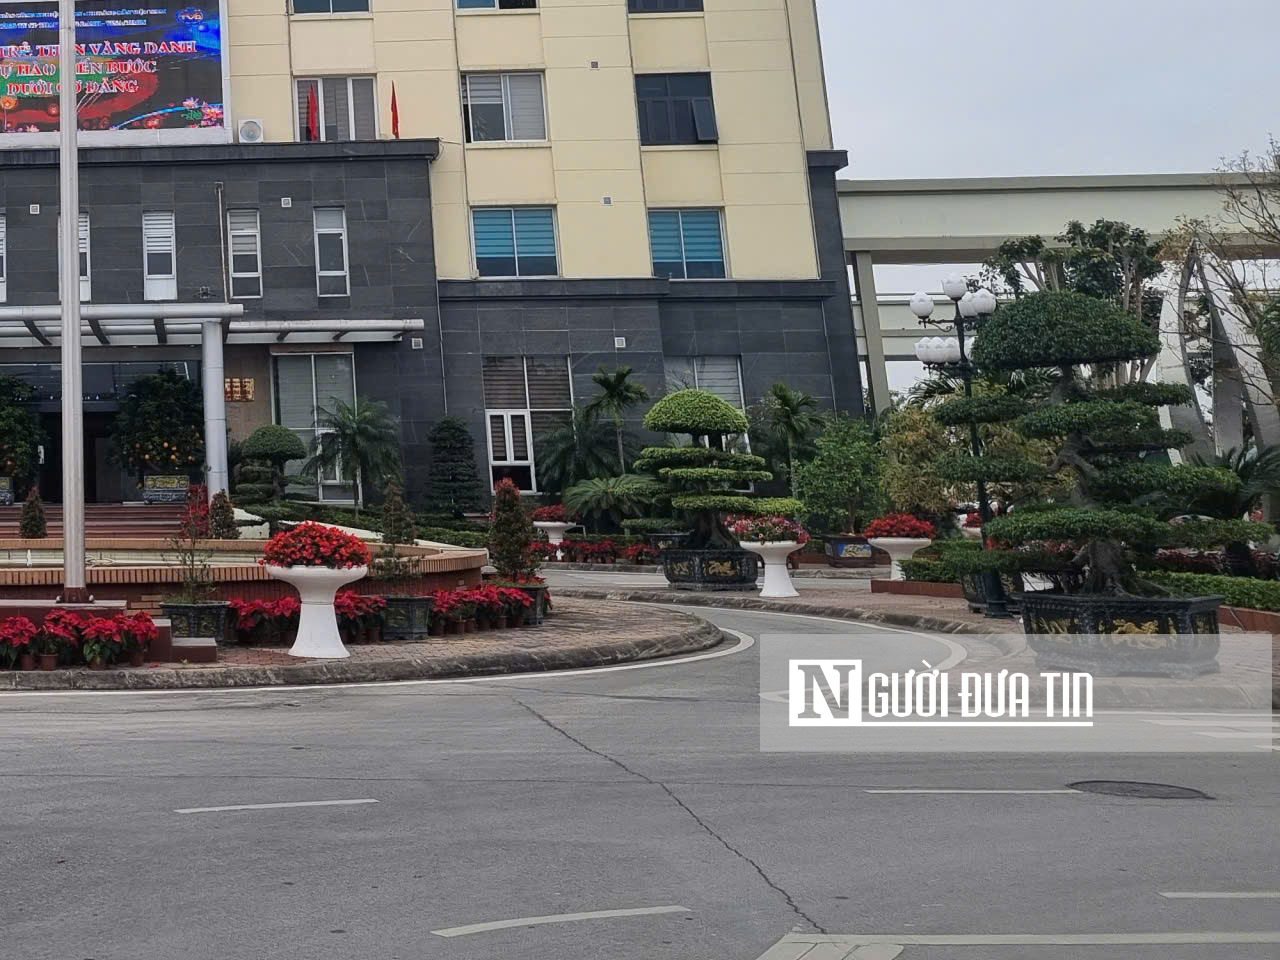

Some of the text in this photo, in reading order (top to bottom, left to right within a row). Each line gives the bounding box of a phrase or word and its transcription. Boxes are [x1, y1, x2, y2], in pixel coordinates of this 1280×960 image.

[89, 40, 141, 55] VÀNG
[144, 40, 197, 54] DANH
[17, 61, 56, 76] HÀO
